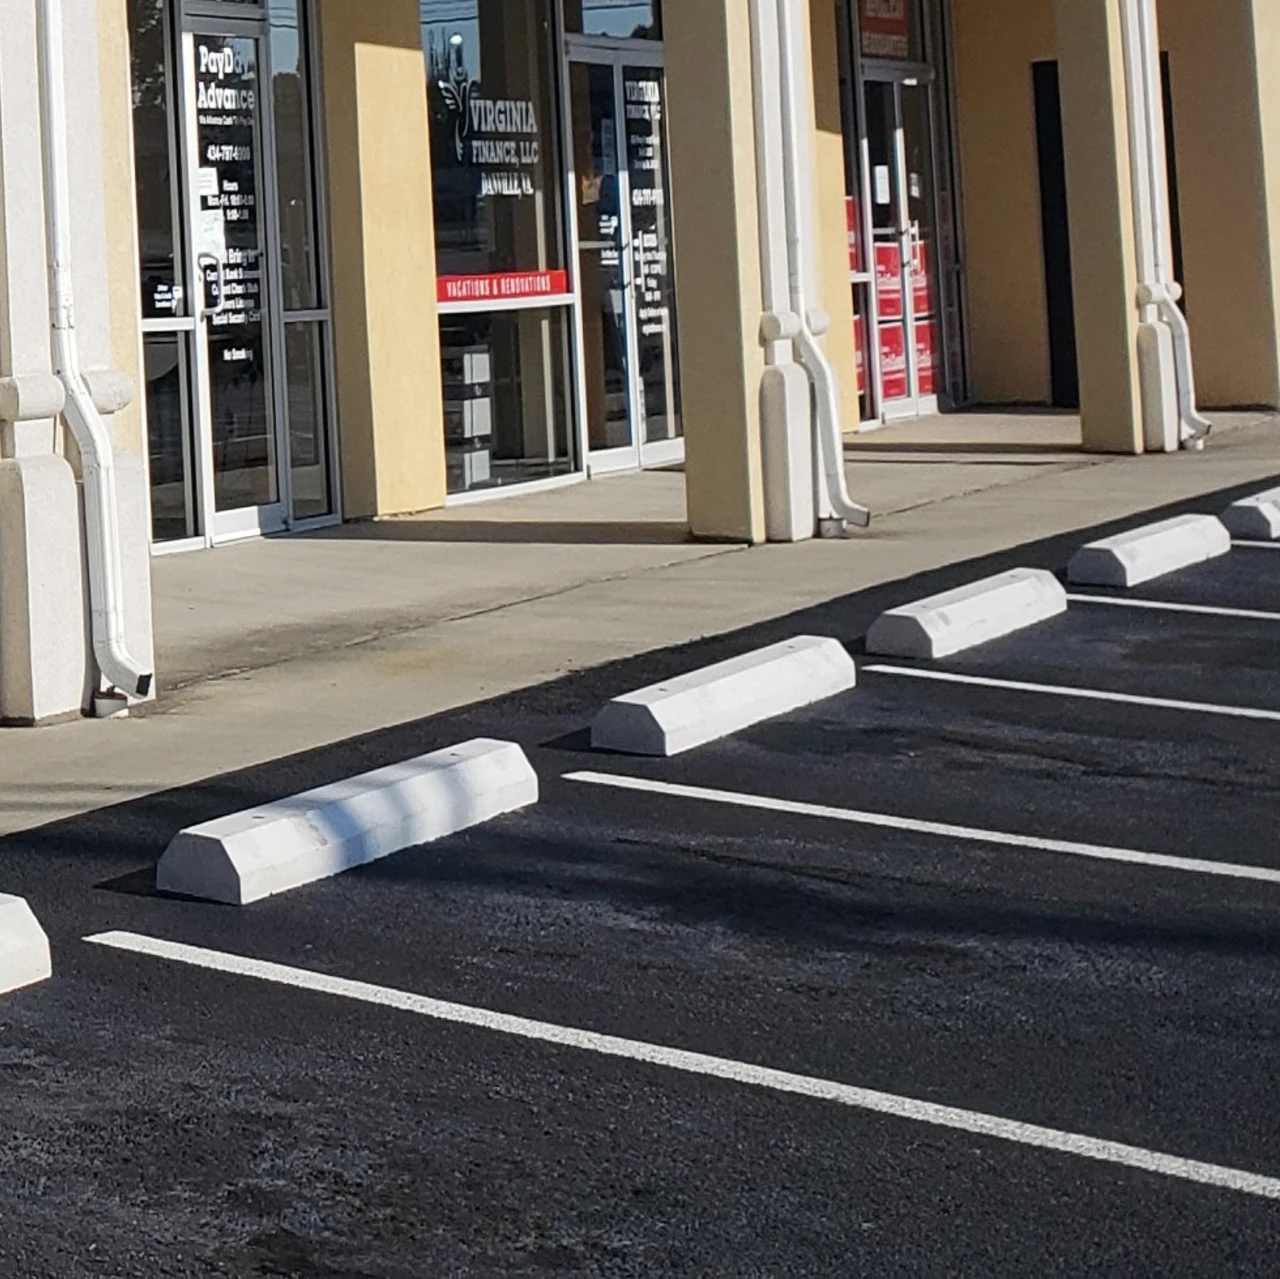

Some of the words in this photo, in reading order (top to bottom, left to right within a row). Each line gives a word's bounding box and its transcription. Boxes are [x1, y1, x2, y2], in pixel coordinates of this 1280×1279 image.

[197, 81, 255, 110] Advance
[471, 99, 538, 133] VIRGINIA
[472, 140, 520, 167] FINANCE,
[520, 141, 539, 163] LLC
[447, 279, 490, 297] VACATIONS
[501, 275, 551, 294] RENOVATIONS
